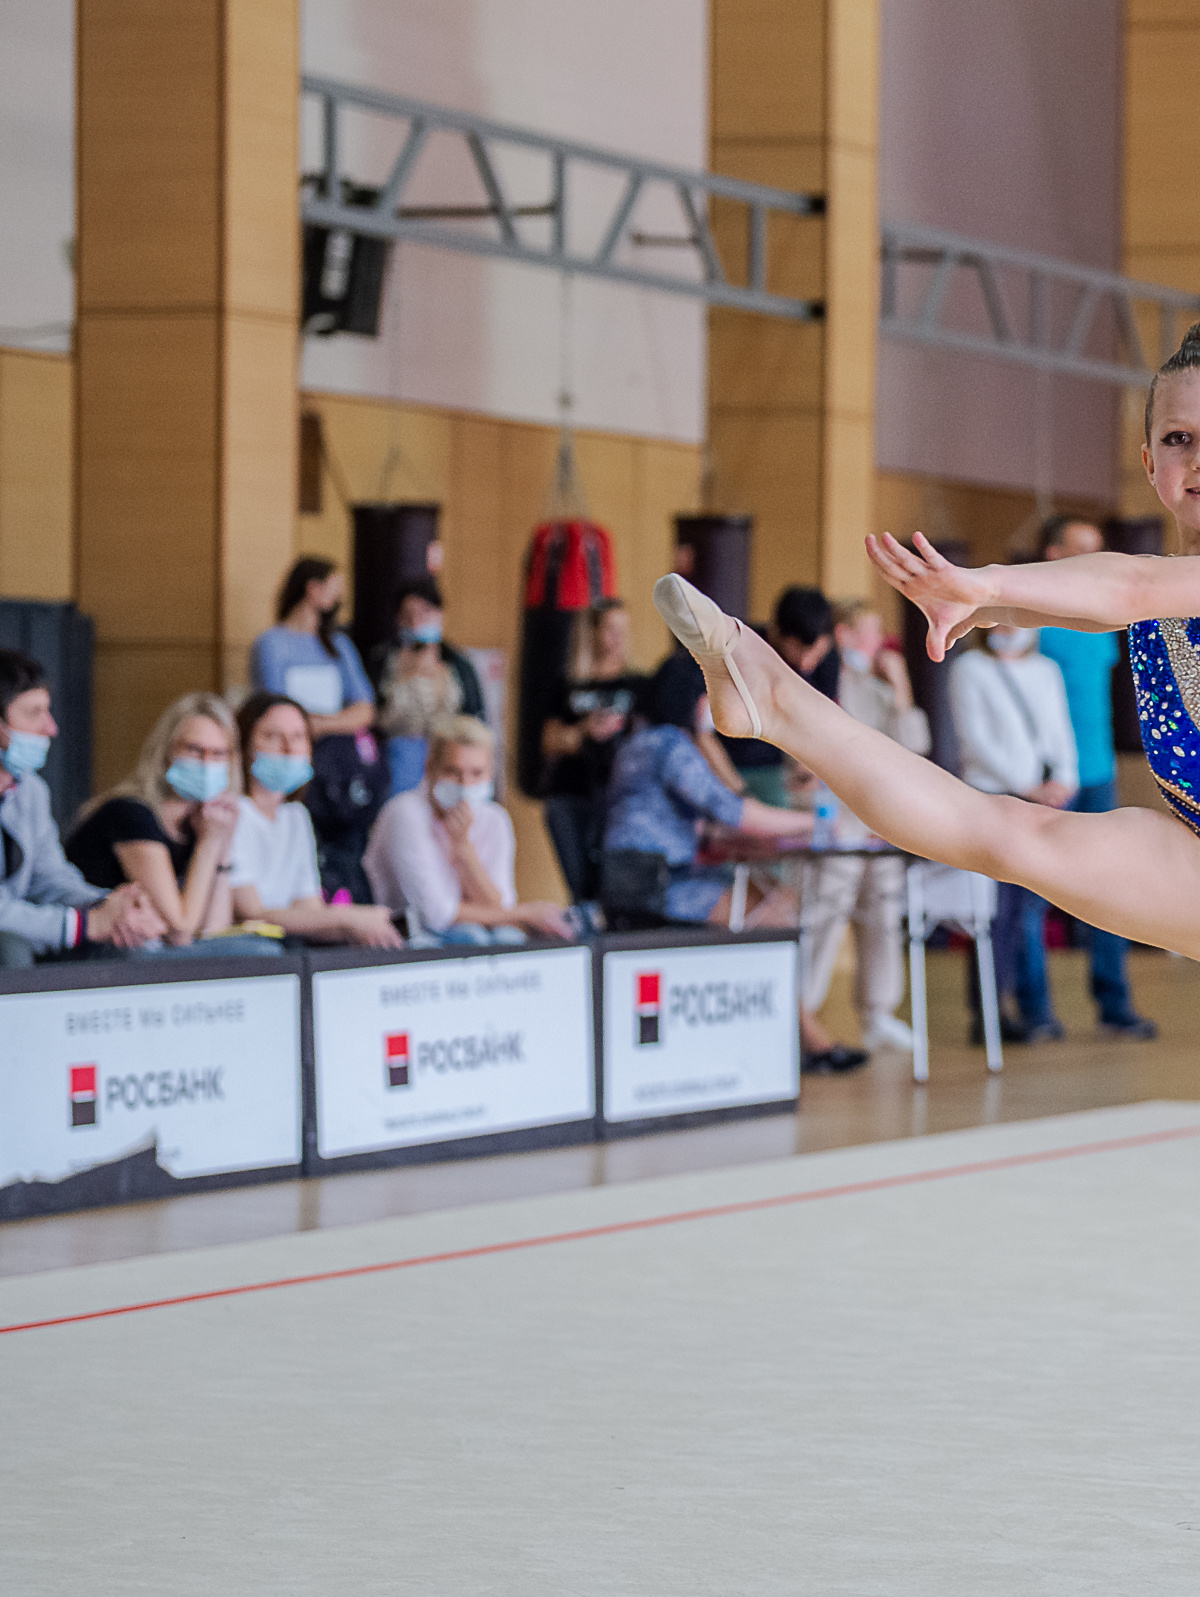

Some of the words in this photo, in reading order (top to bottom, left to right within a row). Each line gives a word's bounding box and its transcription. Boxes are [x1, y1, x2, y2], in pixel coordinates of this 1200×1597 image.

[669, 980, 776, 1027] РОСБАНК
[417, 1030, 526, 1076] РОСБАНК
[105, 1065, 226, 1111] РОСБАНК
